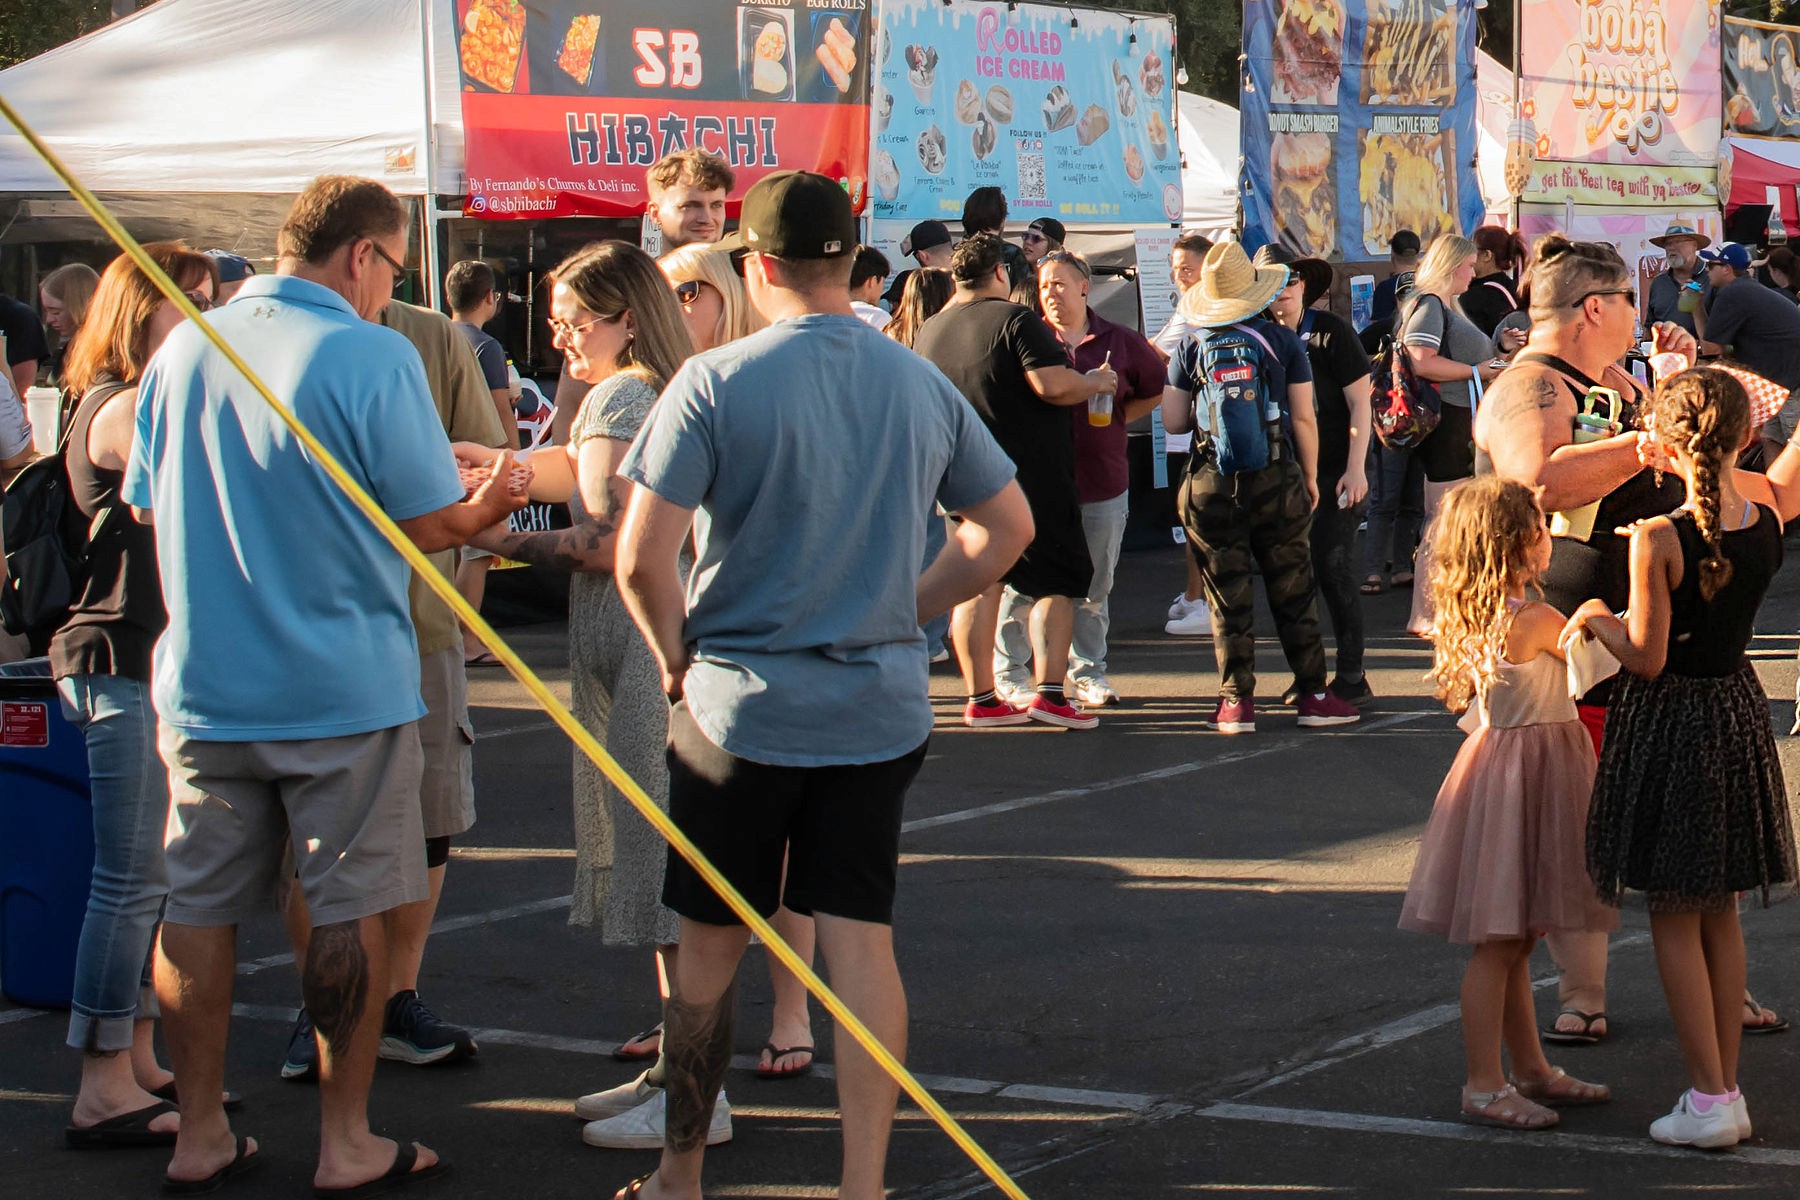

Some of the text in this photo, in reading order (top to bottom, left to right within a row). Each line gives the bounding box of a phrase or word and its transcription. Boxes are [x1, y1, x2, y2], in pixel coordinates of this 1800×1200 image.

[976, 6, 1062, 55] ROLLED
[633, 27, 703, 90] SB
[976, 55, 1066, 82] ICE CREAM
[1567, 43, 1679, 115] bestie
[566, 111, 779, 167] HIBACHI
[470, 177, 483, 194] By
[547, 177, 586, 191] Churros
[588, 180, 597, 191] &
[598, 179, 618, 192] Deli
[621, 180, 640, 193] inc.
[1541, 173, 1557, 194] get
[1579, 167, 1603, 189] best
[1607, 176, 1624, 197] tea
[1629, 175, 1650, 196] with
[1652, 183, 1667, 202] ya
[1665, 177, 1701, 197] bestie
[489, 196, 557, 212] @sbhibachi
[508, 504, 552, 533] ACHI
